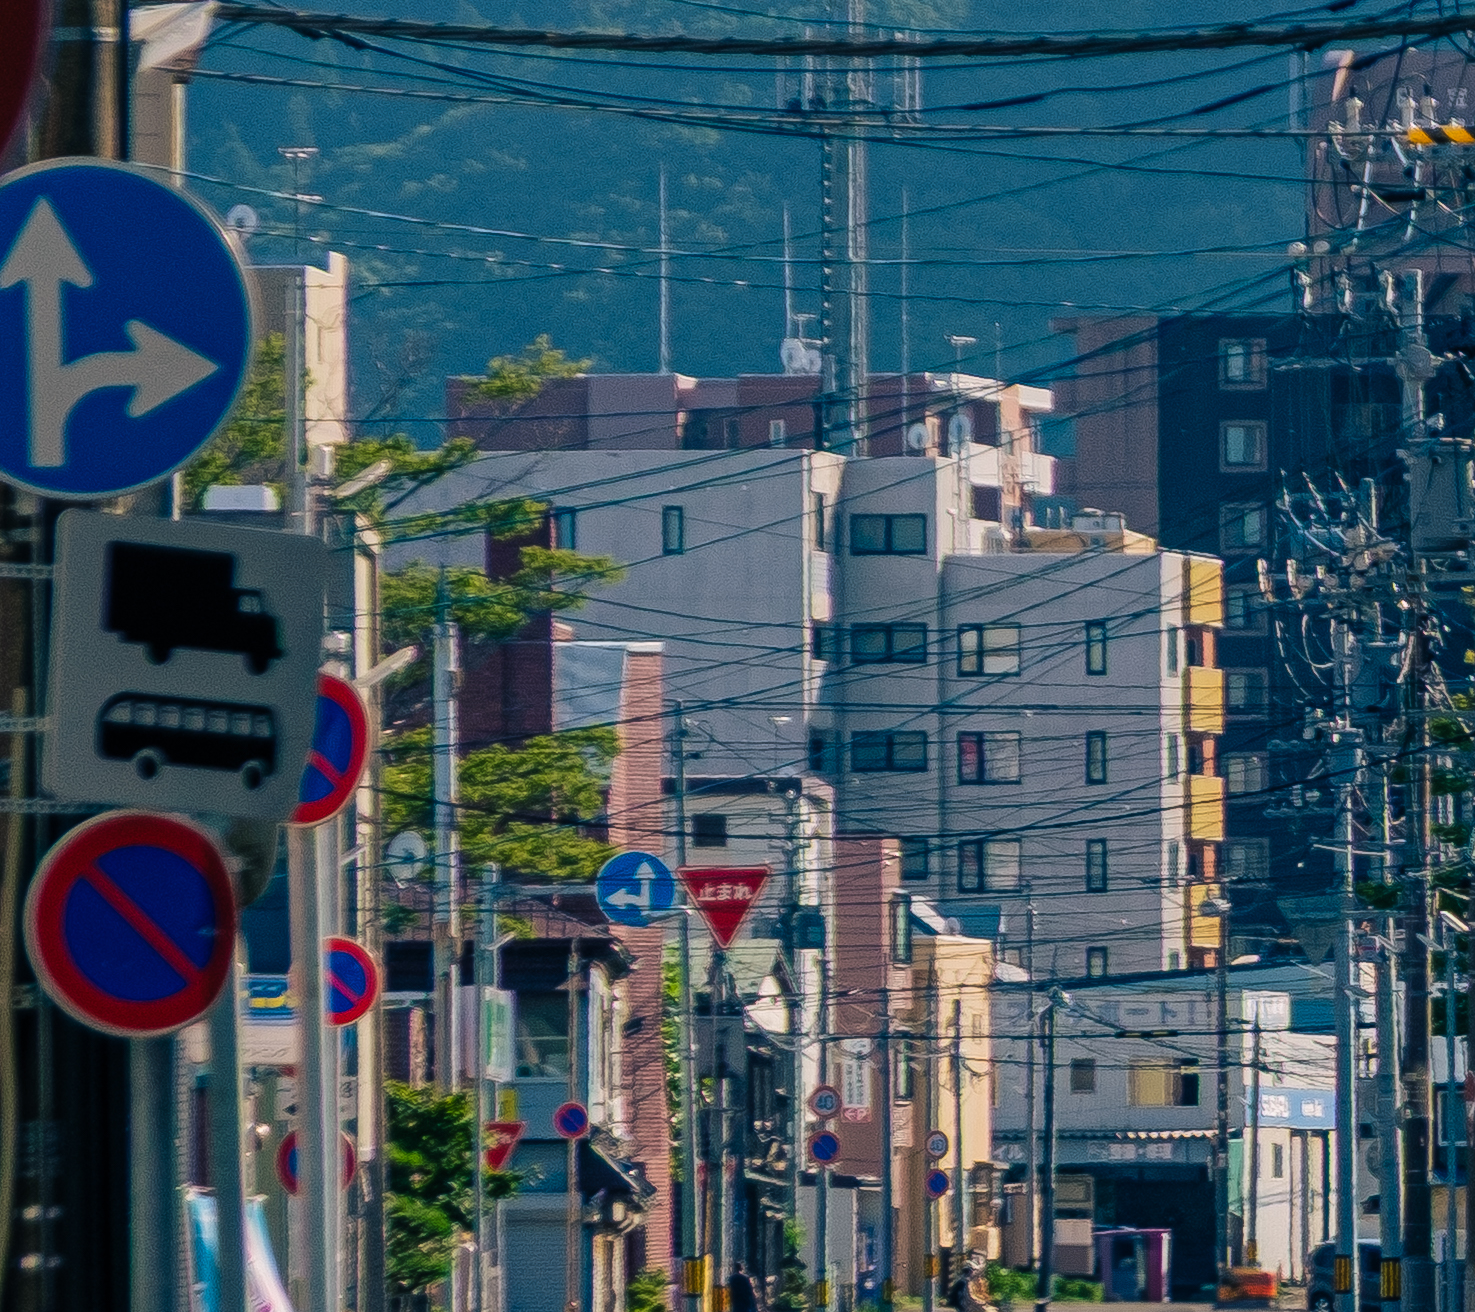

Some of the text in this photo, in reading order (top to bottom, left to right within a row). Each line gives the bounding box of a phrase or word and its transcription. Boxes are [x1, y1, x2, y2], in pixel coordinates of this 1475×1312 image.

[697, 882, 753, 901] 止まれ
[816, 1095, 834, 1110] 40
